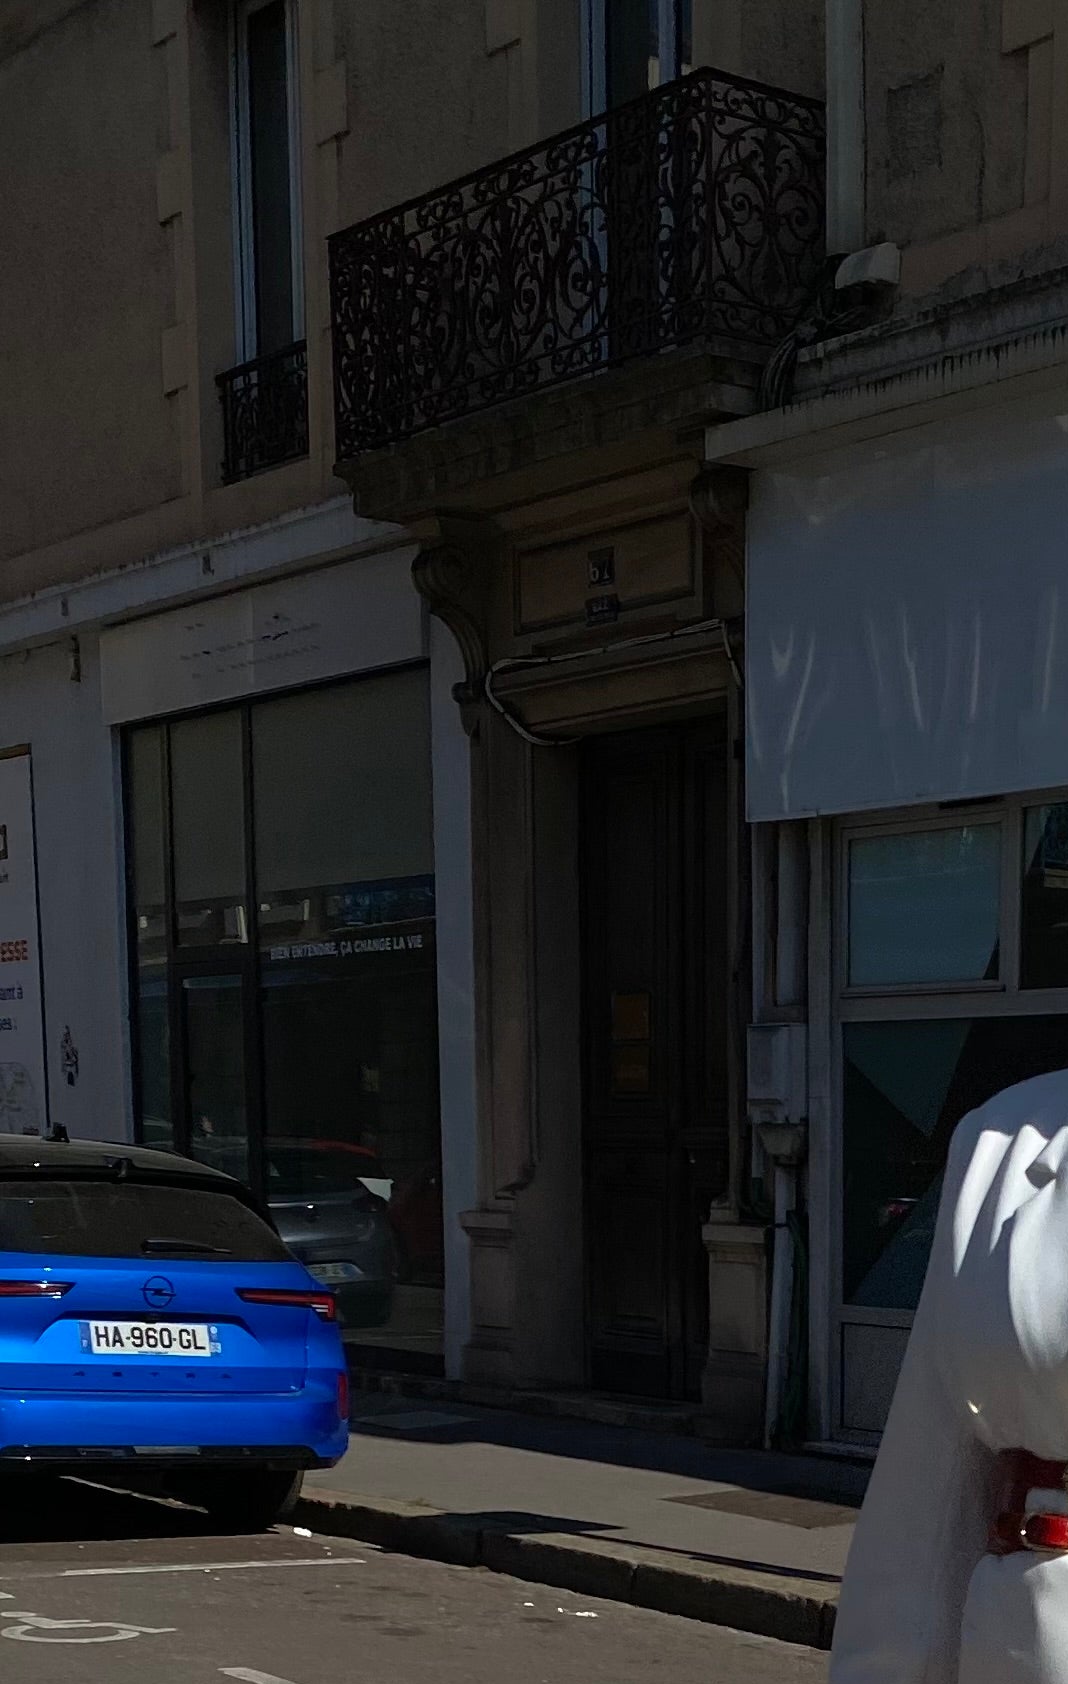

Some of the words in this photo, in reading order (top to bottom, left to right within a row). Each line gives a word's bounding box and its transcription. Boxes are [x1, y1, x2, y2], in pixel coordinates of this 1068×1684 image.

[353, 937, 392, 952] CHANGE
[393, 936, 406, 950] LA
[407, 934, 424, 949] VIE
[94, 1325, 206, 1351] HA-960-GL
